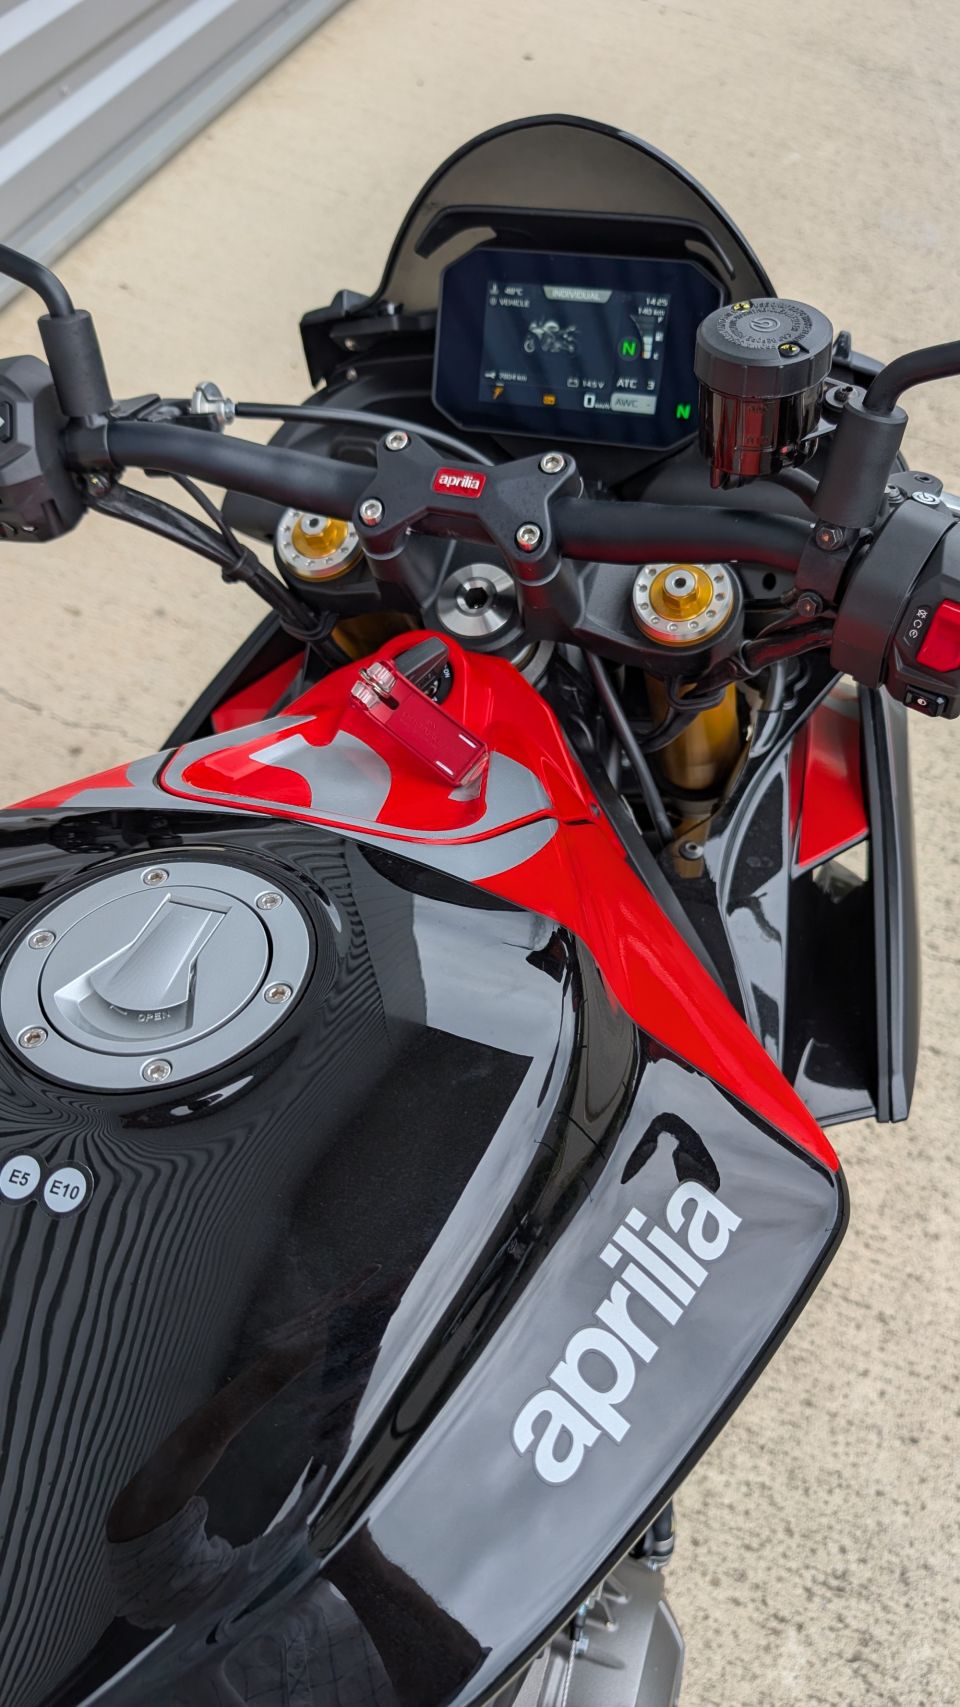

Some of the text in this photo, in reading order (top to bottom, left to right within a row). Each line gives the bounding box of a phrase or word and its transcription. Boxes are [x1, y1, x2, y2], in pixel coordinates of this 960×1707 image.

[551, 288, 602, 301] INDIVIDUAL
[499, 298, 530, 308] VEHICLE
[622, 341, 636, 356] N
[616, 378, 655, 390] ATC 3
[584, 393, 596, 409] 0
[615, 399, 638, 408] AWC
[676, 404, 691, 419] N
[438, 474, 480, 490] aprilia
[138, 1011, 172, 1023] OPEN
[8, 1169, 81, 1201] E5 E10
[512, 1180, 743, 1484] aprilia
